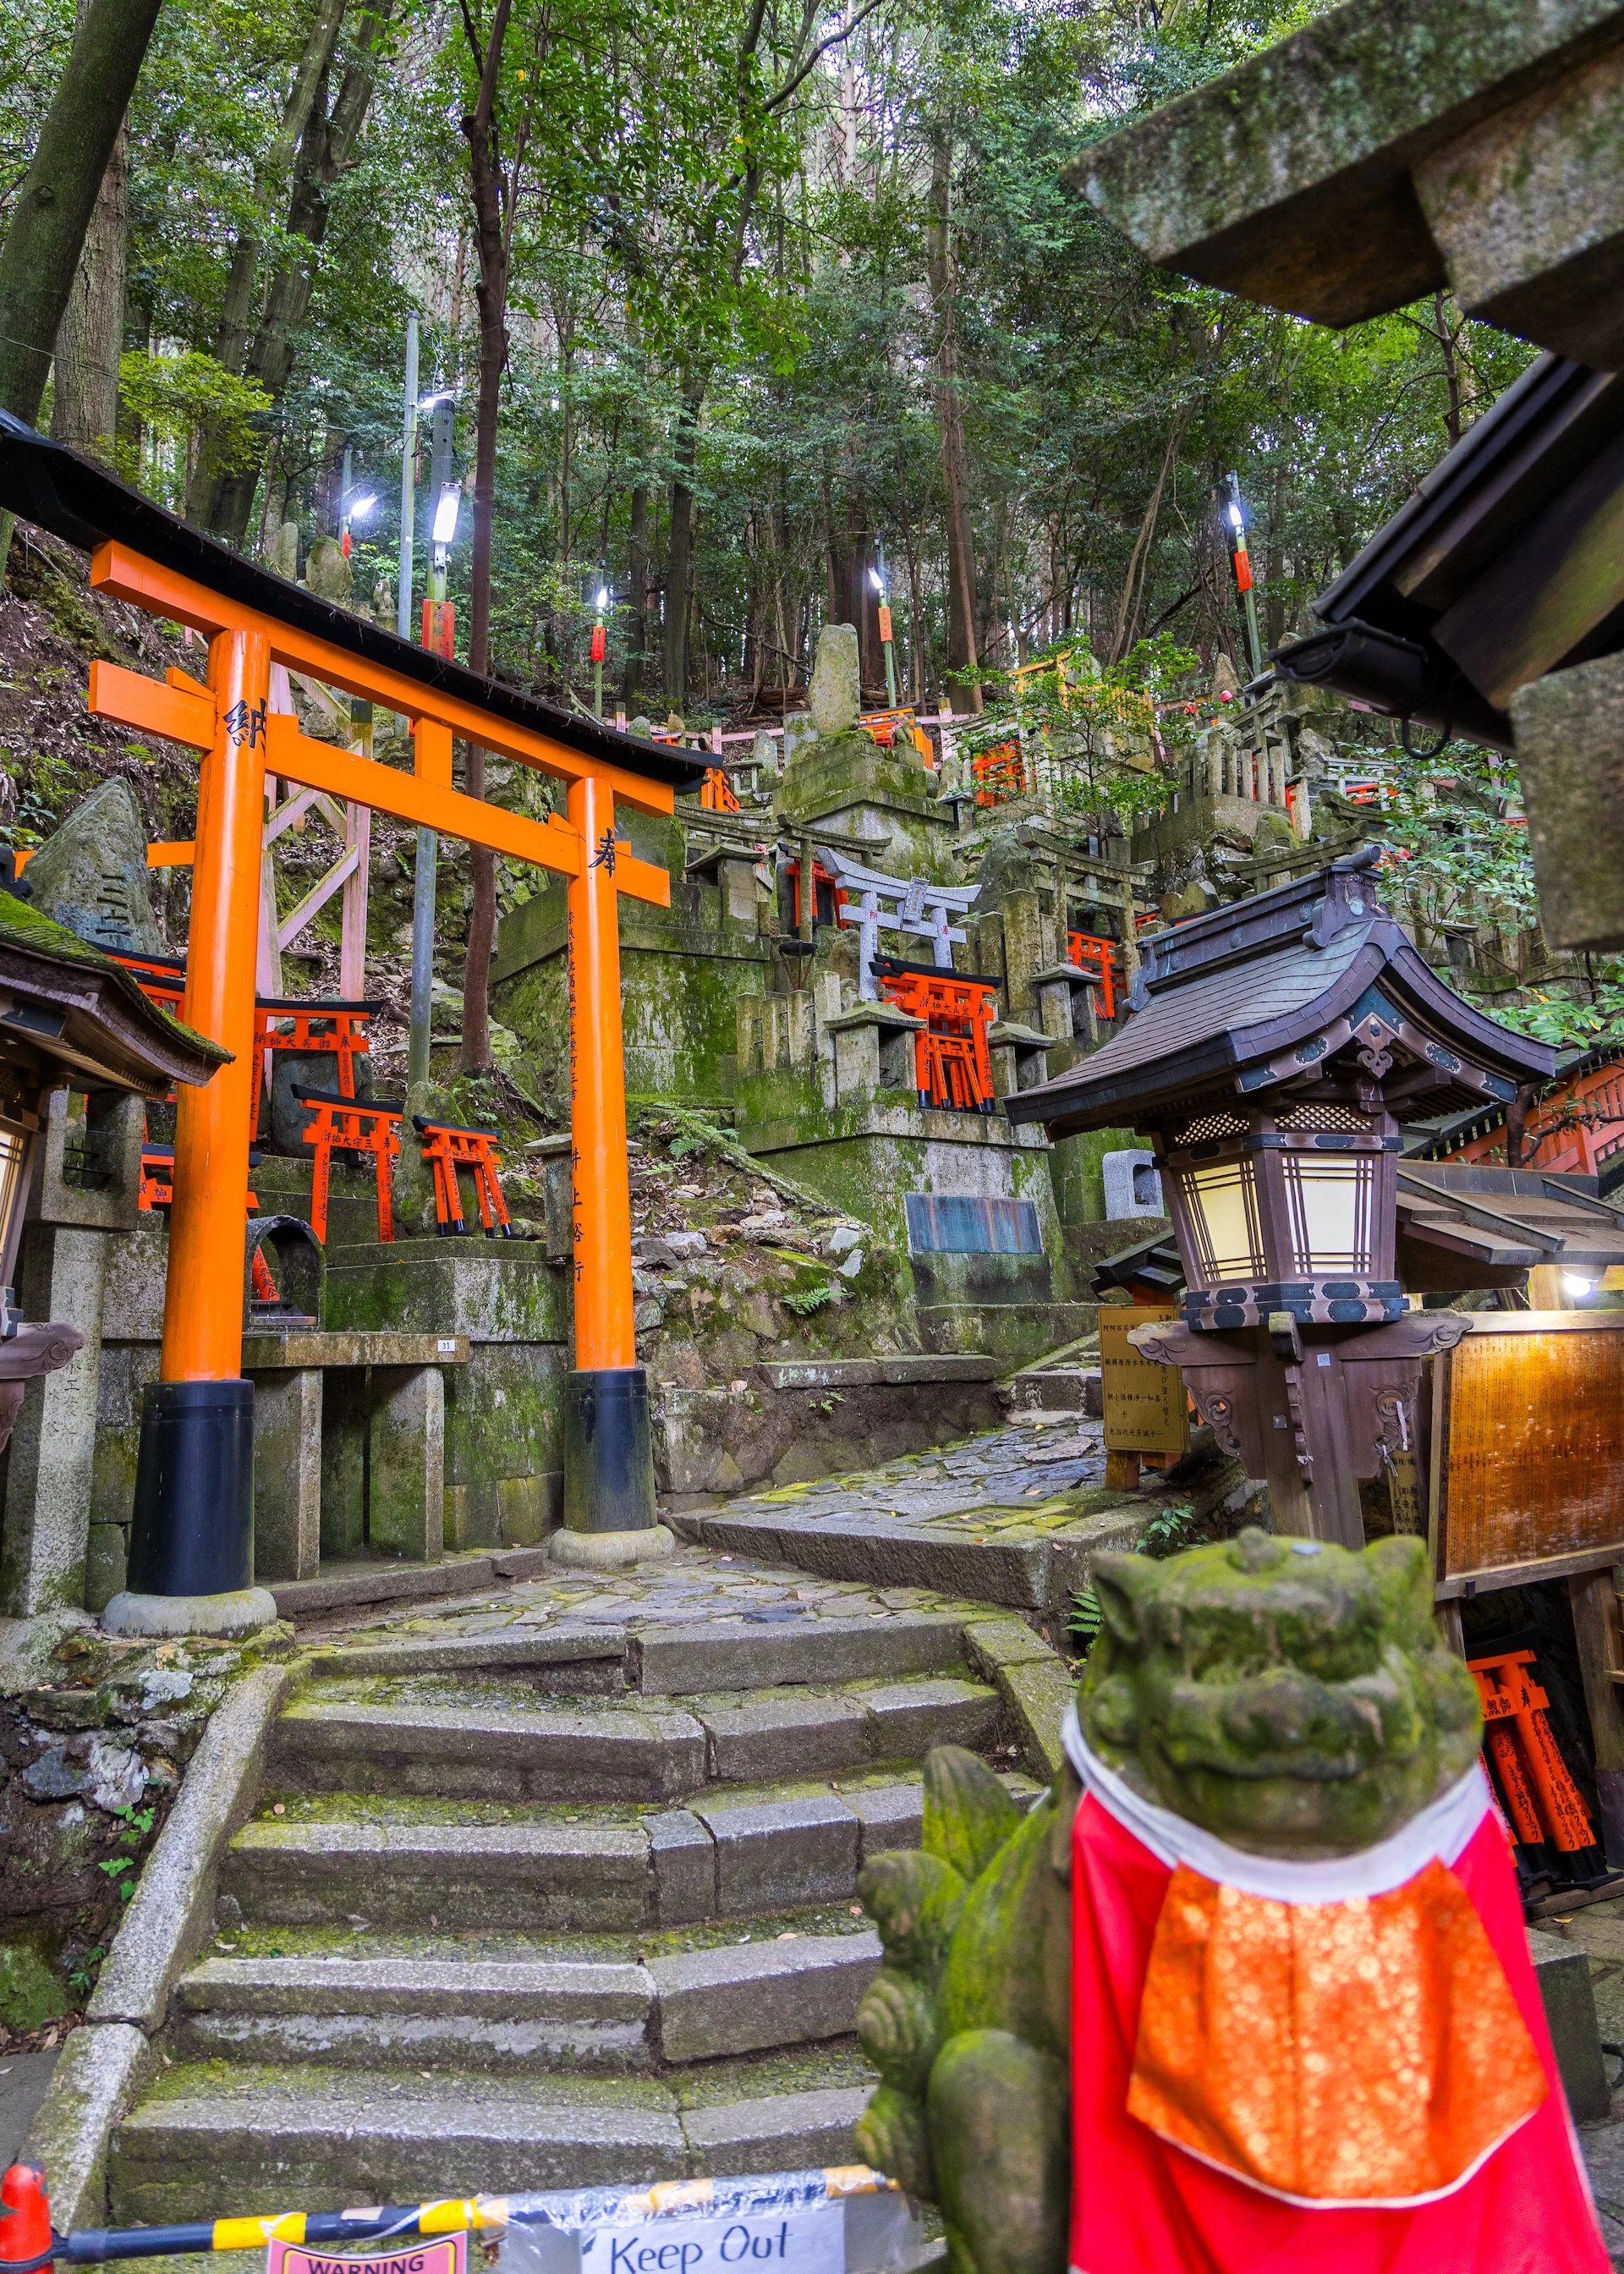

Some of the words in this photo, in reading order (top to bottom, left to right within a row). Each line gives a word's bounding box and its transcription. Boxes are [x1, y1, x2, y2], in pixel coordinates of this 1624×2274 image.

[223, 697, 266, 758] 納
[587, 829, 616, 878] 奉
[308, 2255, 425, 2274] WARNING
[612, 2237, 704, 2274] Keep
[720, 2222, 793, 2263] Out
